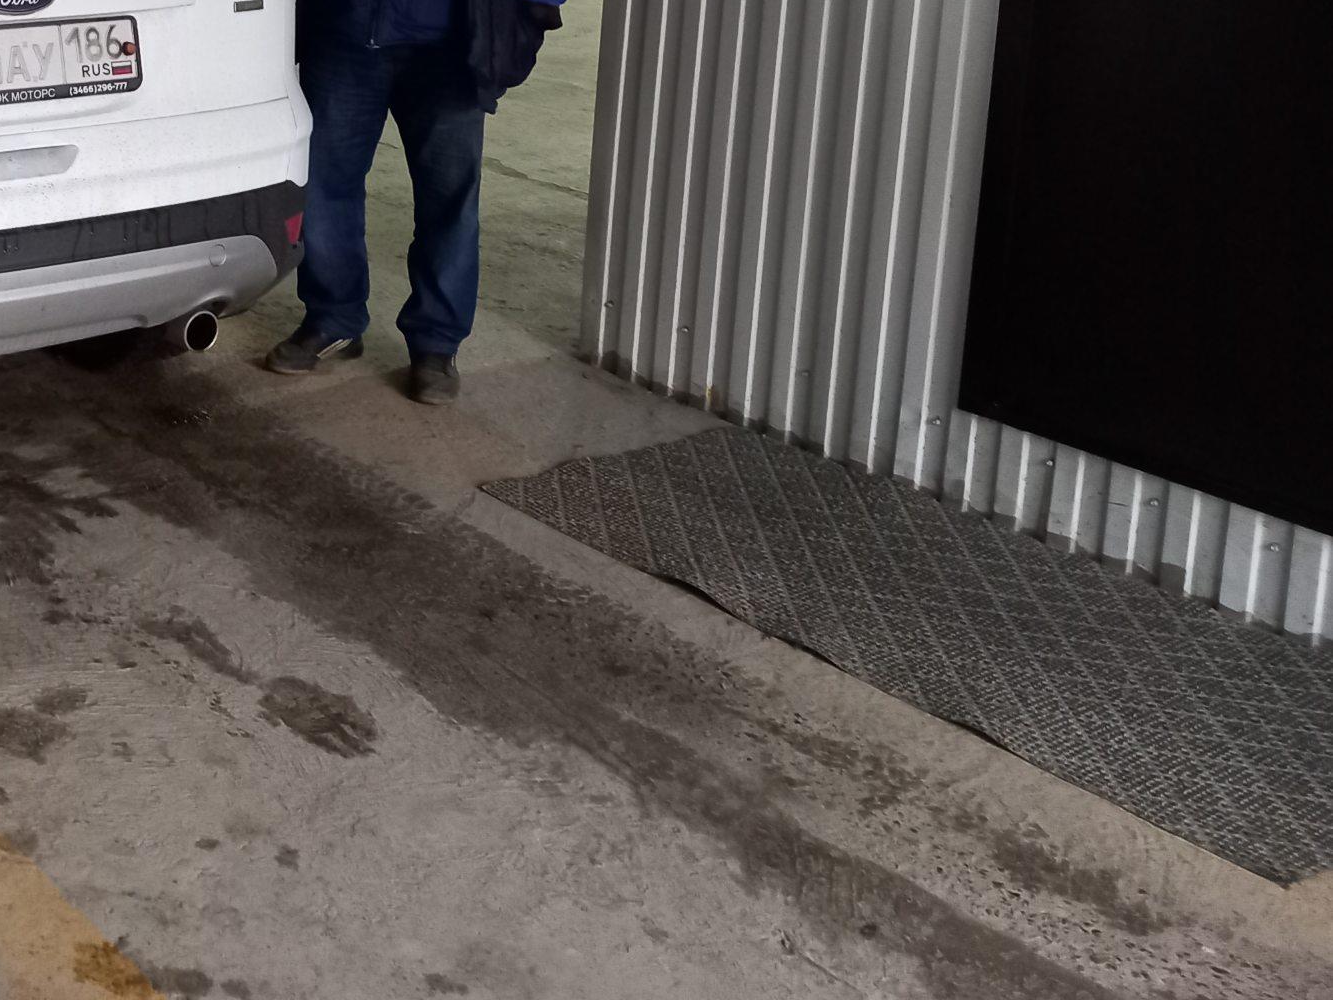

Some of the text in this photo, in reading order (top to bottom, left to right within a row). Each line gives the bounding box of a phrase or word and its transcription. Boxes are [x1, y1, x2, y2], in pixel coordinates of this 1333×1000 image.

[64, 24, 122, 64] 186
[81, 62, 111, 78] RUS
[11, 88, 56, 102] МОТОРС
